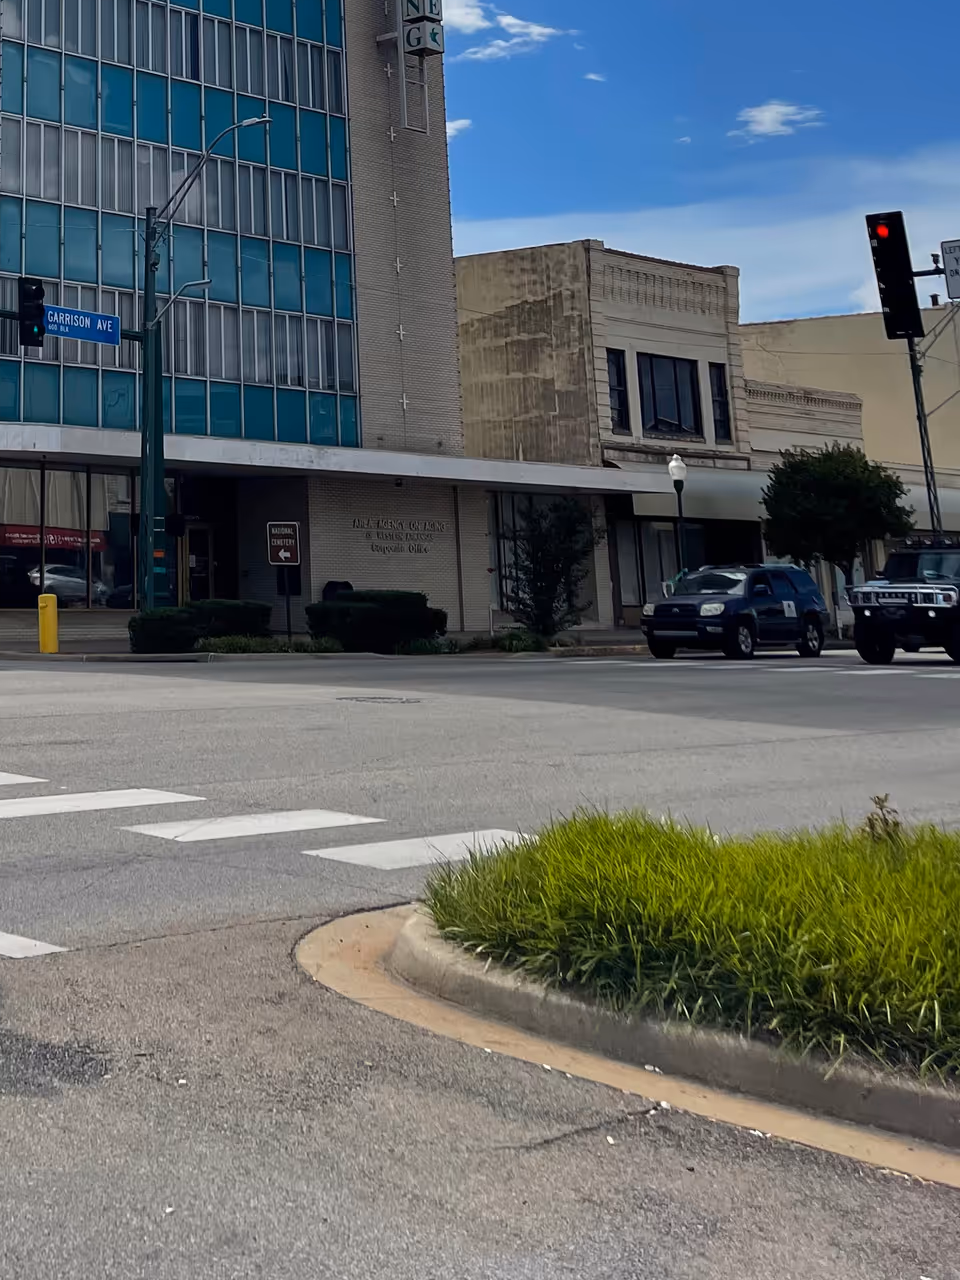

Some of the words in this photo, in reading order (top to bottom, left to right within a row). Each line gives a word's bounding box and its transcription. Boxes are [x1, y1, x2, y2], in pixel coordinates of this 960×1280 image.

[47, 310, 91, 329] GARRISON
[96, 319, 113, 332] AVE
[376, 518, 406, 530] AGENCY
